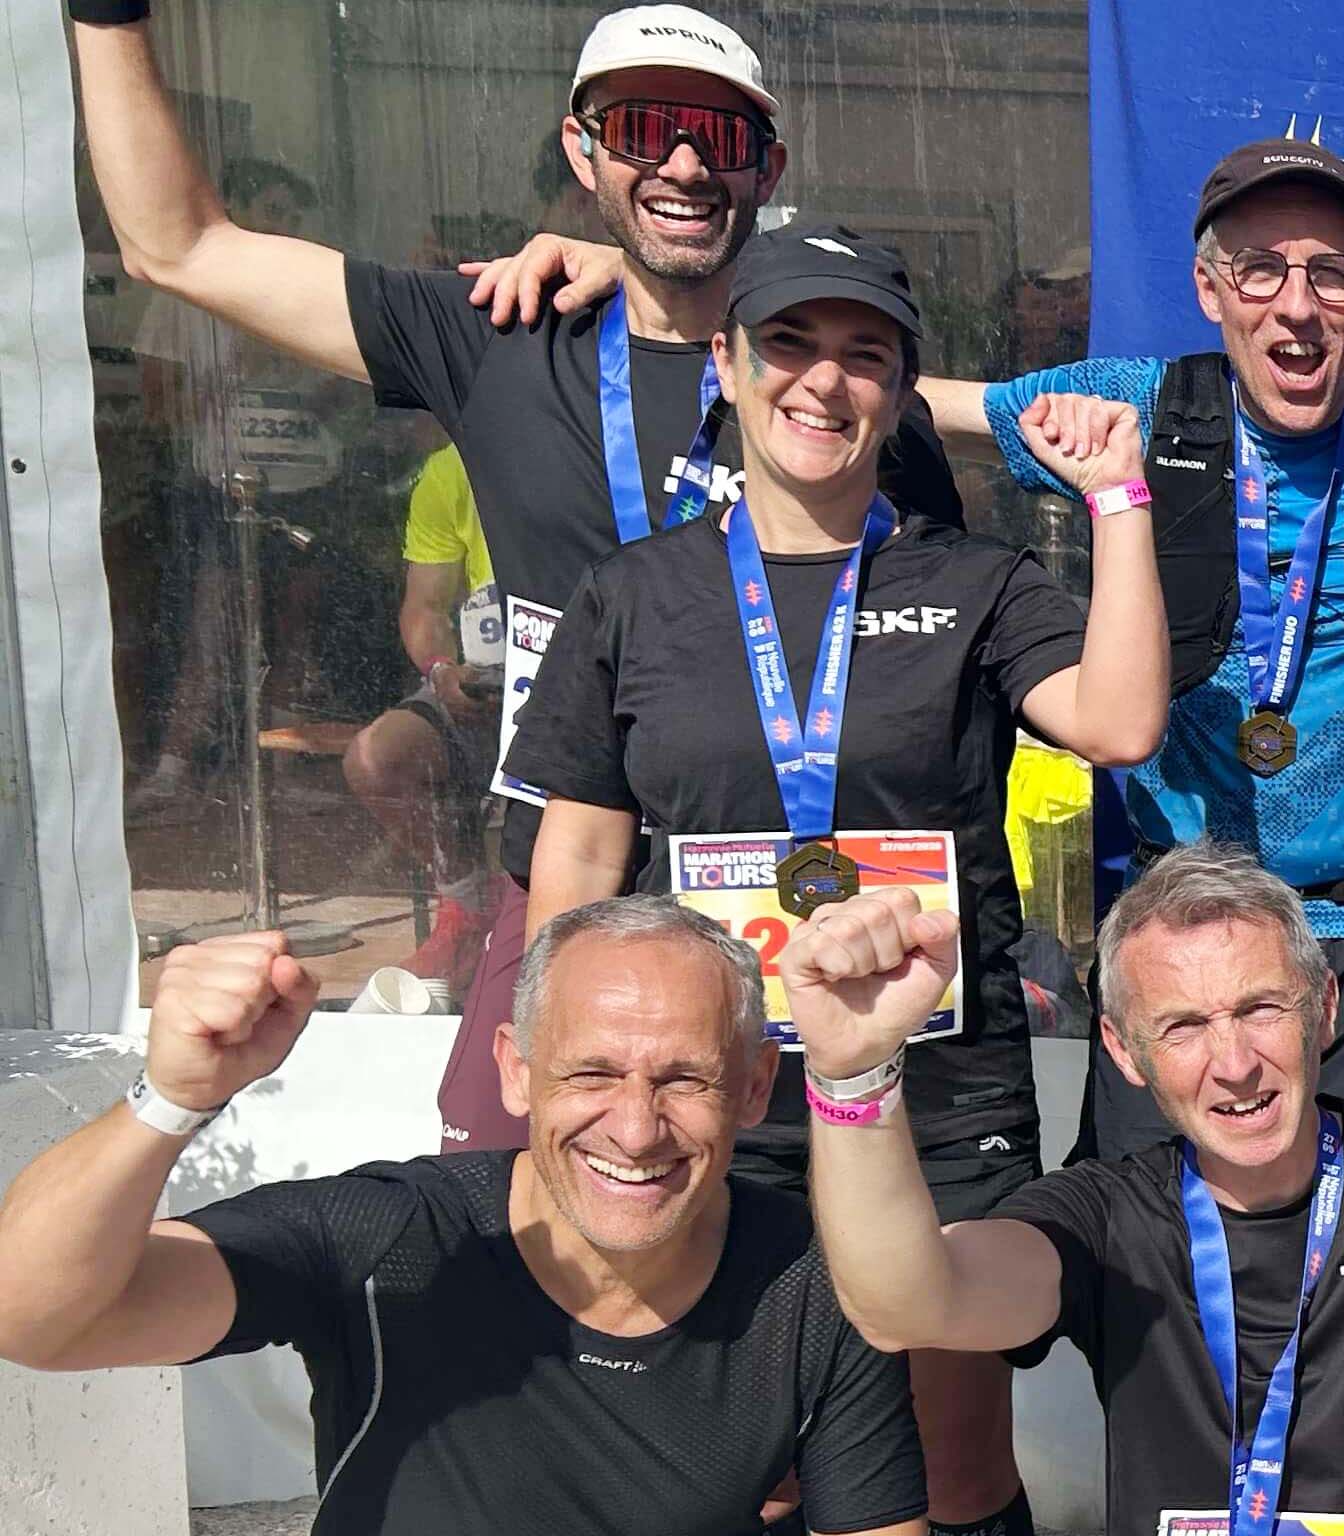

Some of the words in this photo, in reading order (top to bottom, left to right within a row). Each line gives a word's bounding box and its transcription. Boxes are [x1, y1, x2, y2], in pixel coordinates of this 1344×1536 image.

[639, 26, 727, 55] KIPRUN
[854, 606, 958, 637] SKF
[1282, 615, 1298, 646] DUO
[684, 851, 777, 867] MARATHON
[684, 864, 777, 887] TOURS
[578, 1353, 633, 1372] CRAFT
